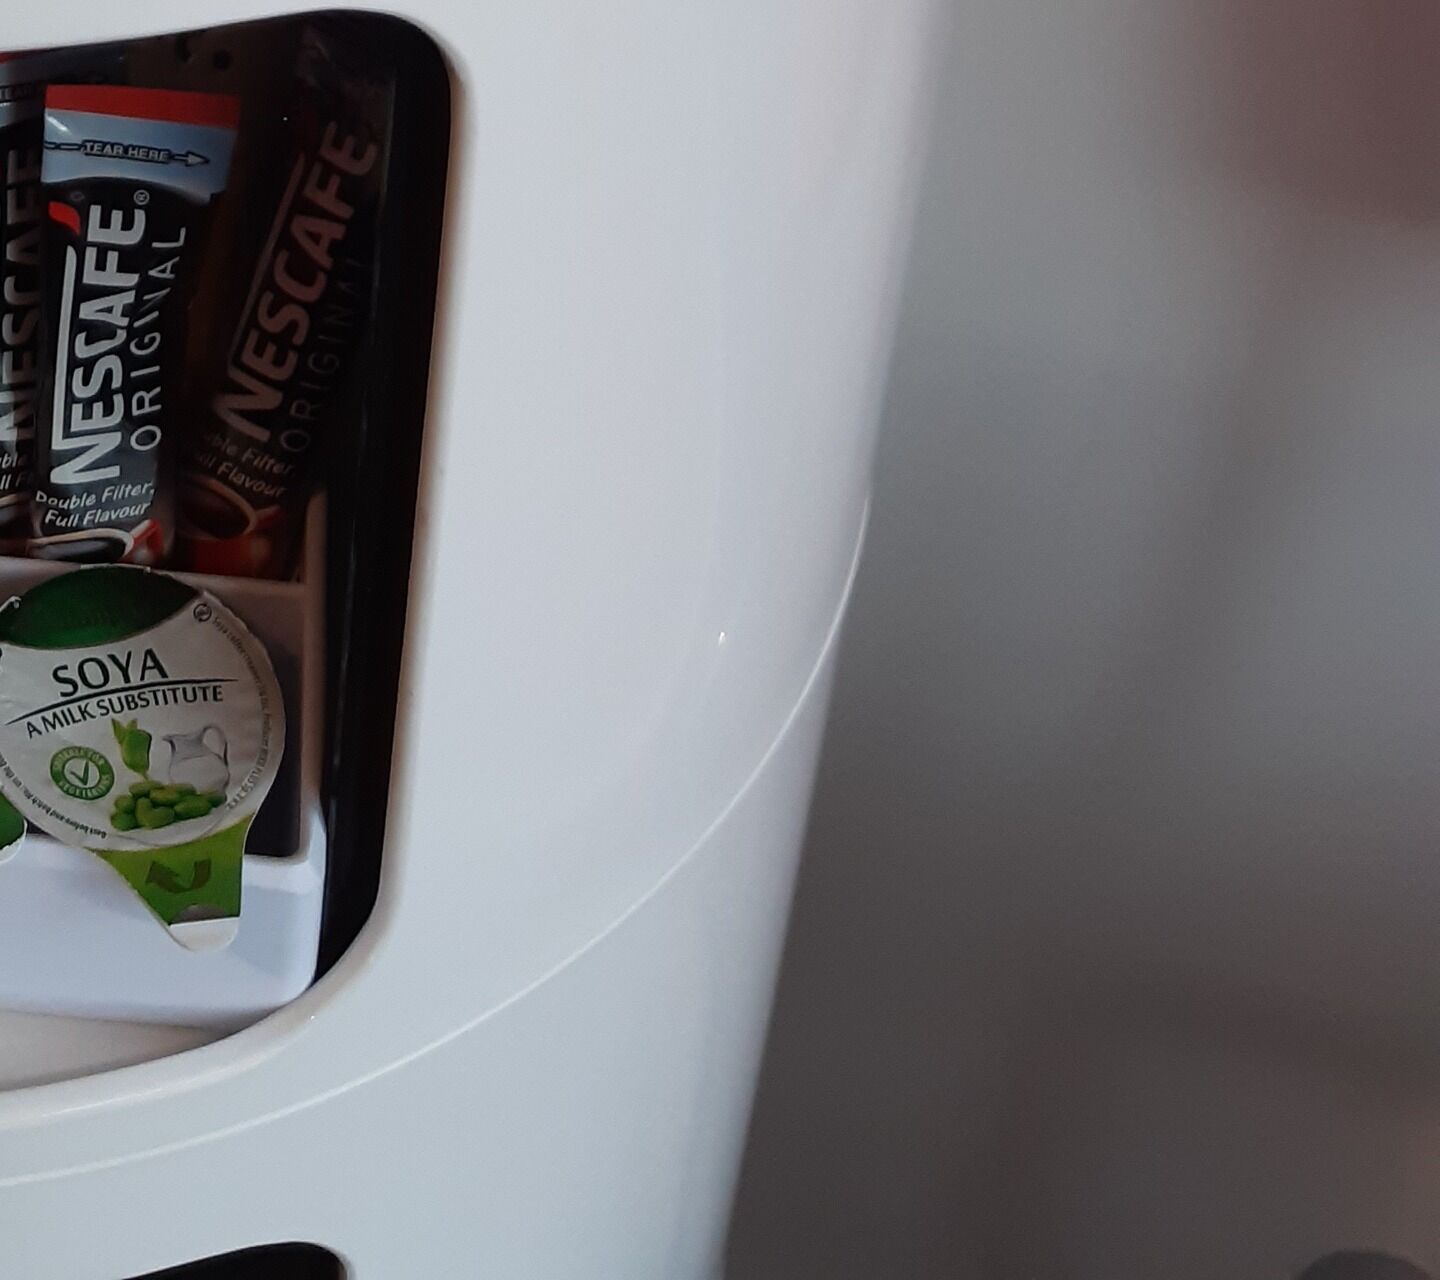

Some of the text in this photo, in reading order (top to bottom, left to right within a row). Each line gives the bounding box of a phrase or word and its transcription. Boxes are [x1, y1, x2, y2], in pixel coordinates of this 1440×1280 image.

[83, 141, 171, 163] TEAR HERE
[35, 489, 96, 509] Double
[44, 501, 152, 528] Full Flavour
[51, 647, 170, 699] SOYA
[25, 720, 43, 740] A
[41, 701, 95, 734] MILK
[98, 684, 225, 718] SUBSTITUTE
